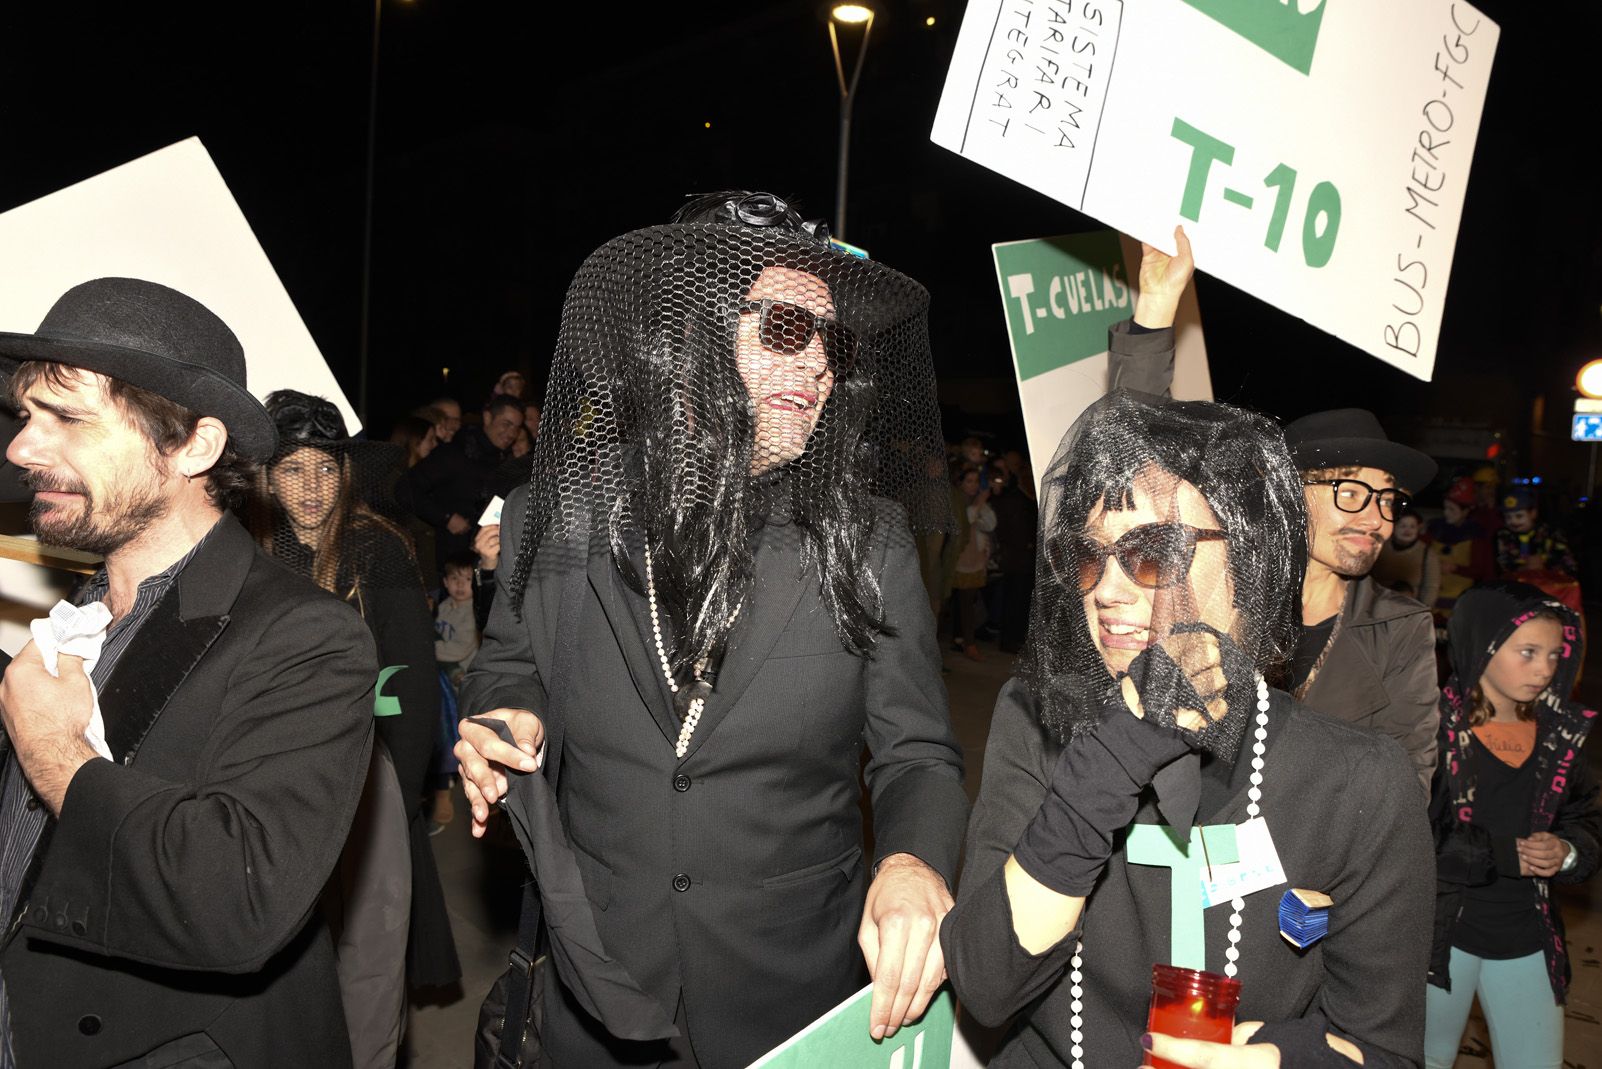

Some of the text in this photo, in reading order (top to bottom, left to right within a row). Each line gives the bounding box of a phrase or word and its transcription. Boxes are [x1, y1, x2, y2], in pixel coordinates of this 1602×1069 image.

[988, 0, 1034, 137] TEGRAT
[1053, 2, 1102, 148] SISTEMA
[1170, 116, 1342, 268] T-10
[1007, 263, 1128, 336] T-CUELAS
